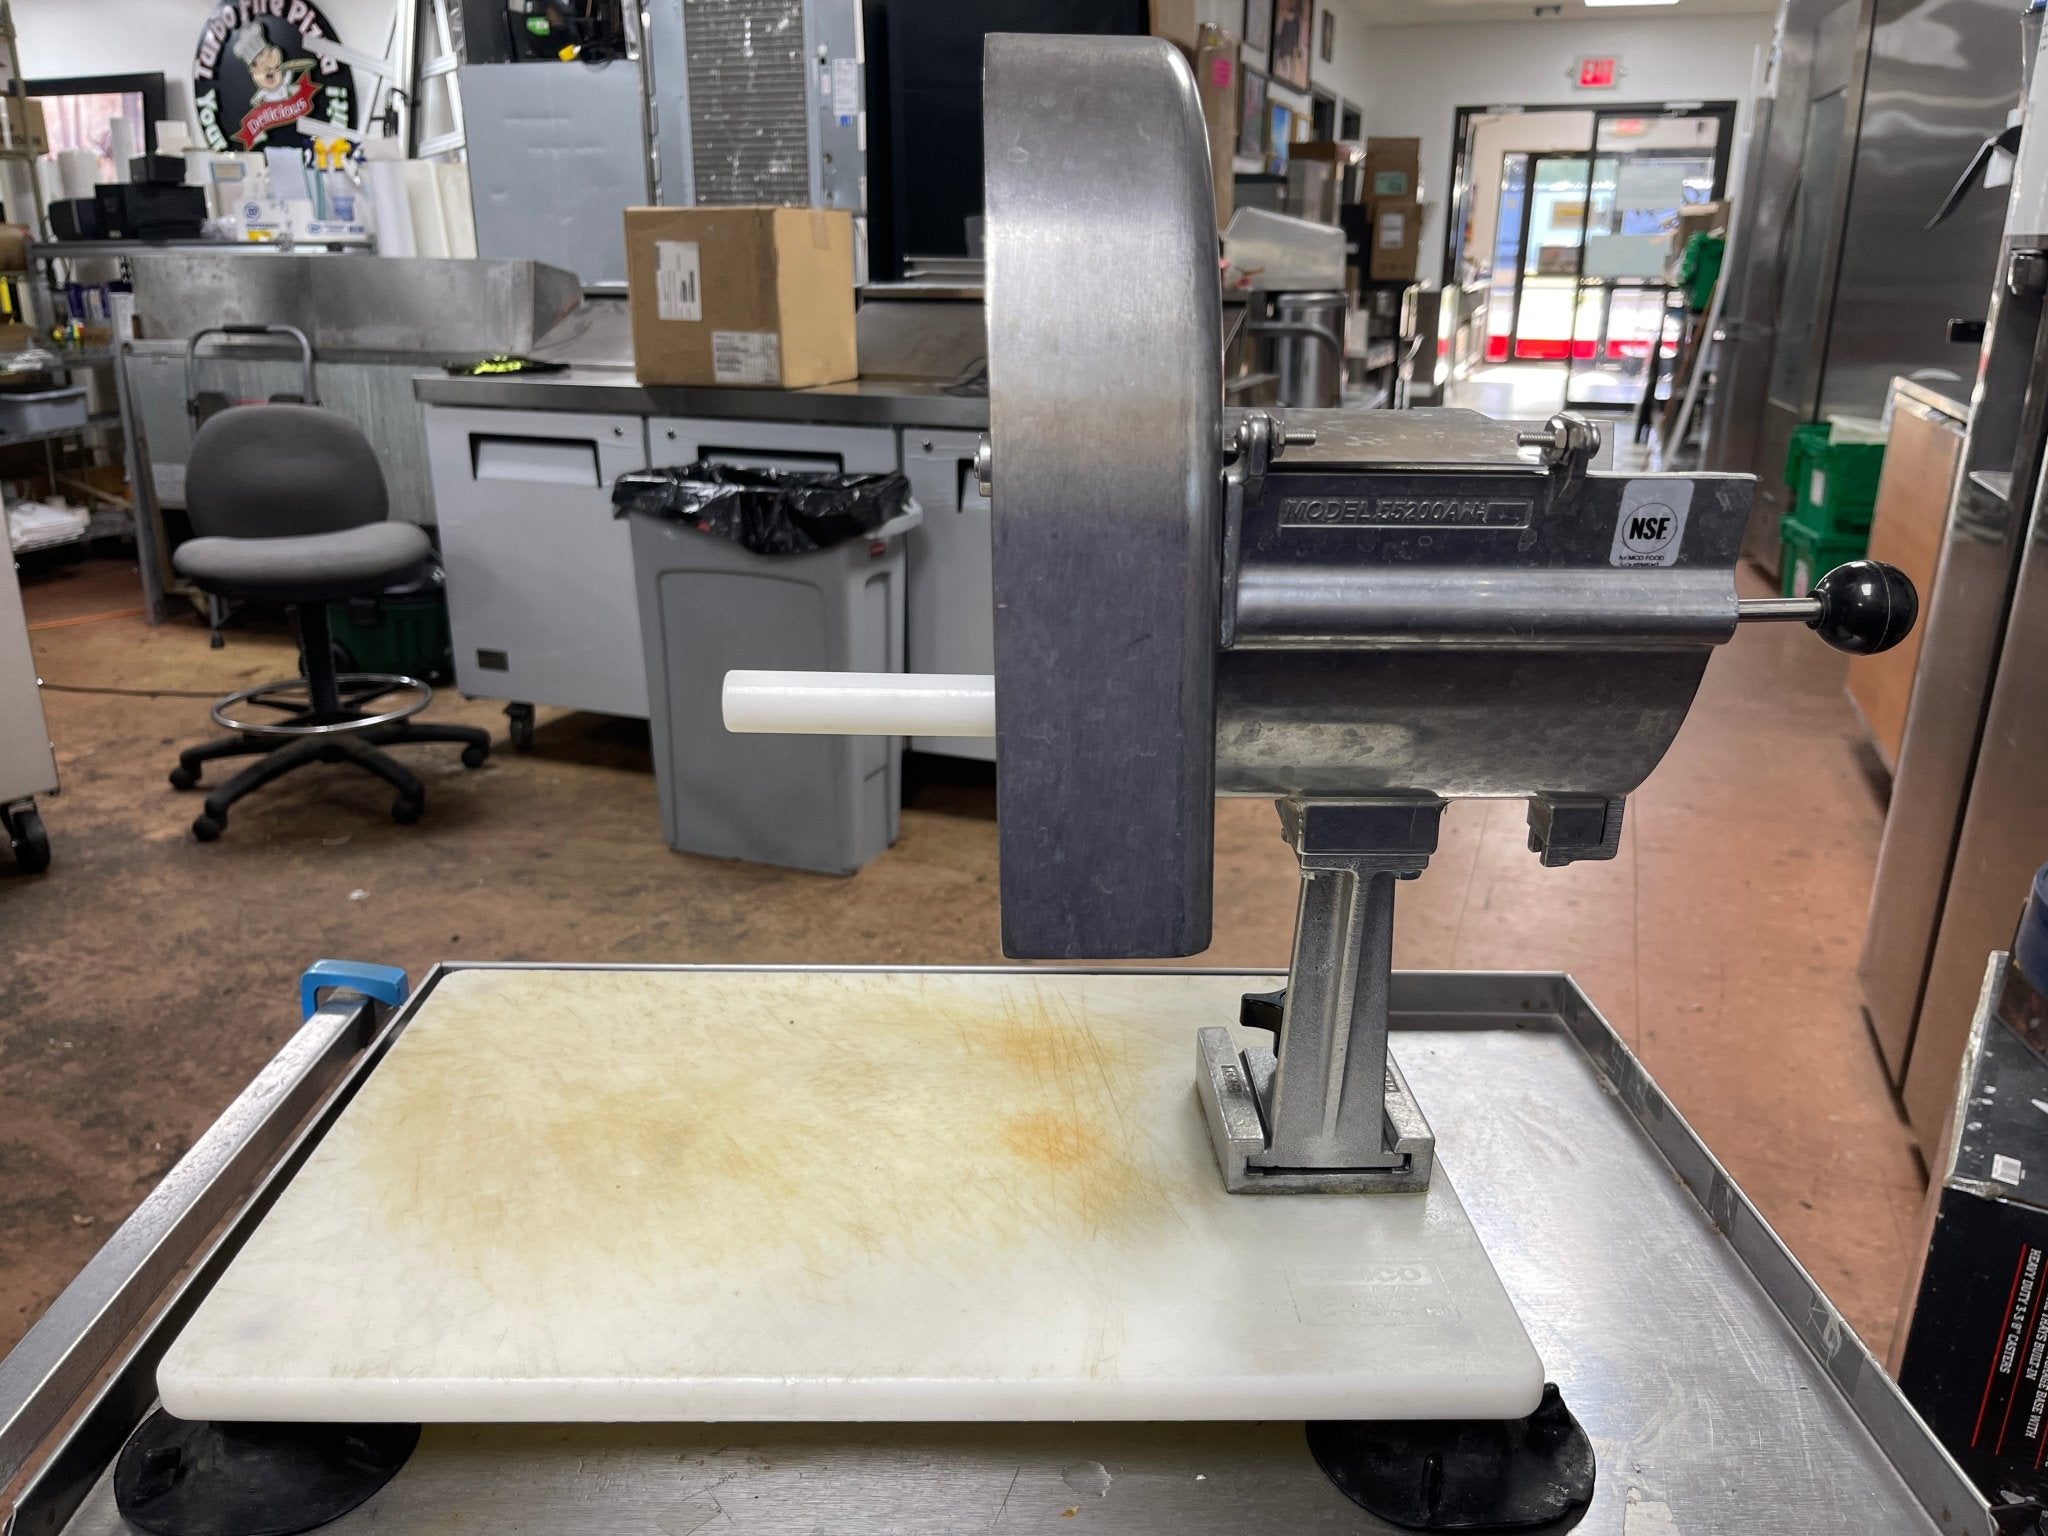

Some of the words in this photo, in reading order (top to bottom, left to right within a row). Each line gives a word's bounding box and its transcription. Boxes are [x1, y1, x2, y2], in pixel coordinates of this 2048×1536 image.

[194, 4, 238, 80] Turbo
[239, 0, 286, 21] Fire
[286, 0, 340, 76] Piza
[247, 97, 308, 136] Delicious
[1285, 499, 1371, 519] MODEL
[1628, 517, 1671, 540] NSF
[2024, 1248, 2042, 1281] HEAVY
[2018, 1279, 2034, 1306] DUTY
[2000, 1333, 2019, 1374] CASTERS
[2025, 1341, 2046, 1381] BUILT-IN
[2031, 1390, 2048, 1415] BASE
[2025, 1414, 2041, 1439] WITH
